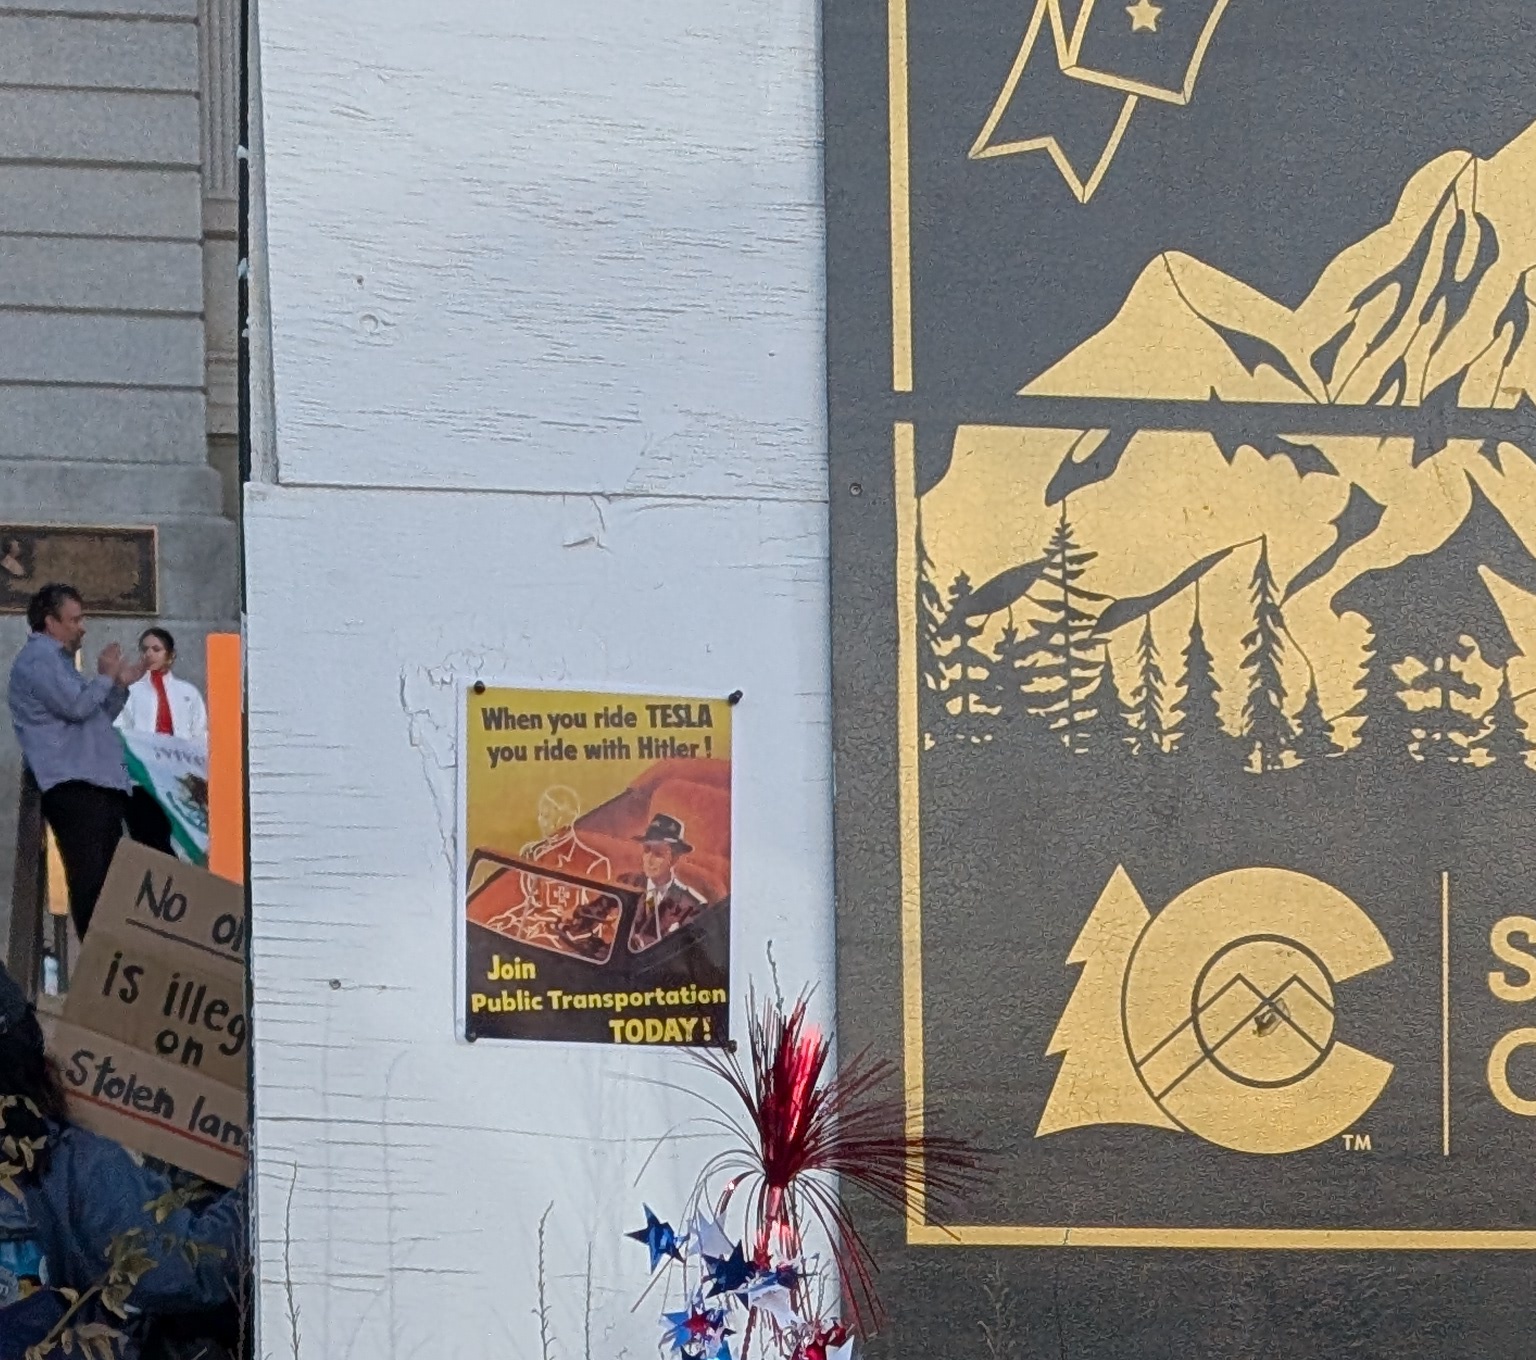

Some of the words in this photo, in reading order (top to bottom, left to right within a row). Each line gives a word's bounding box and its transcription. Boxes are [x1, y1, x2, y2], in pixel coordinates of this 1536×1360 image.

[481, 707, 543, 730] When
[547, 711, 588, 735] you
[594, 705, 637, 729] ride
[645, 703, 713, 728] TESLA
[486, 744, 527, 768] you
[534, 739, 578, 762] ride
[584, 737, 631, 760] with
[134, 869, 188, 923] No
[487, 955, 537, 981] Join
[101, 951, 144, 1004] is
[162, 971, 246, 1056] illeg
[471, 989, 544, 1013] Public
[547, 983, 727, 1012] Transportation
[155, 1029, 204, 1067] on
[188, 1095, 249, 1152] lan
[1341, 1134, 1372, 1151] TM
